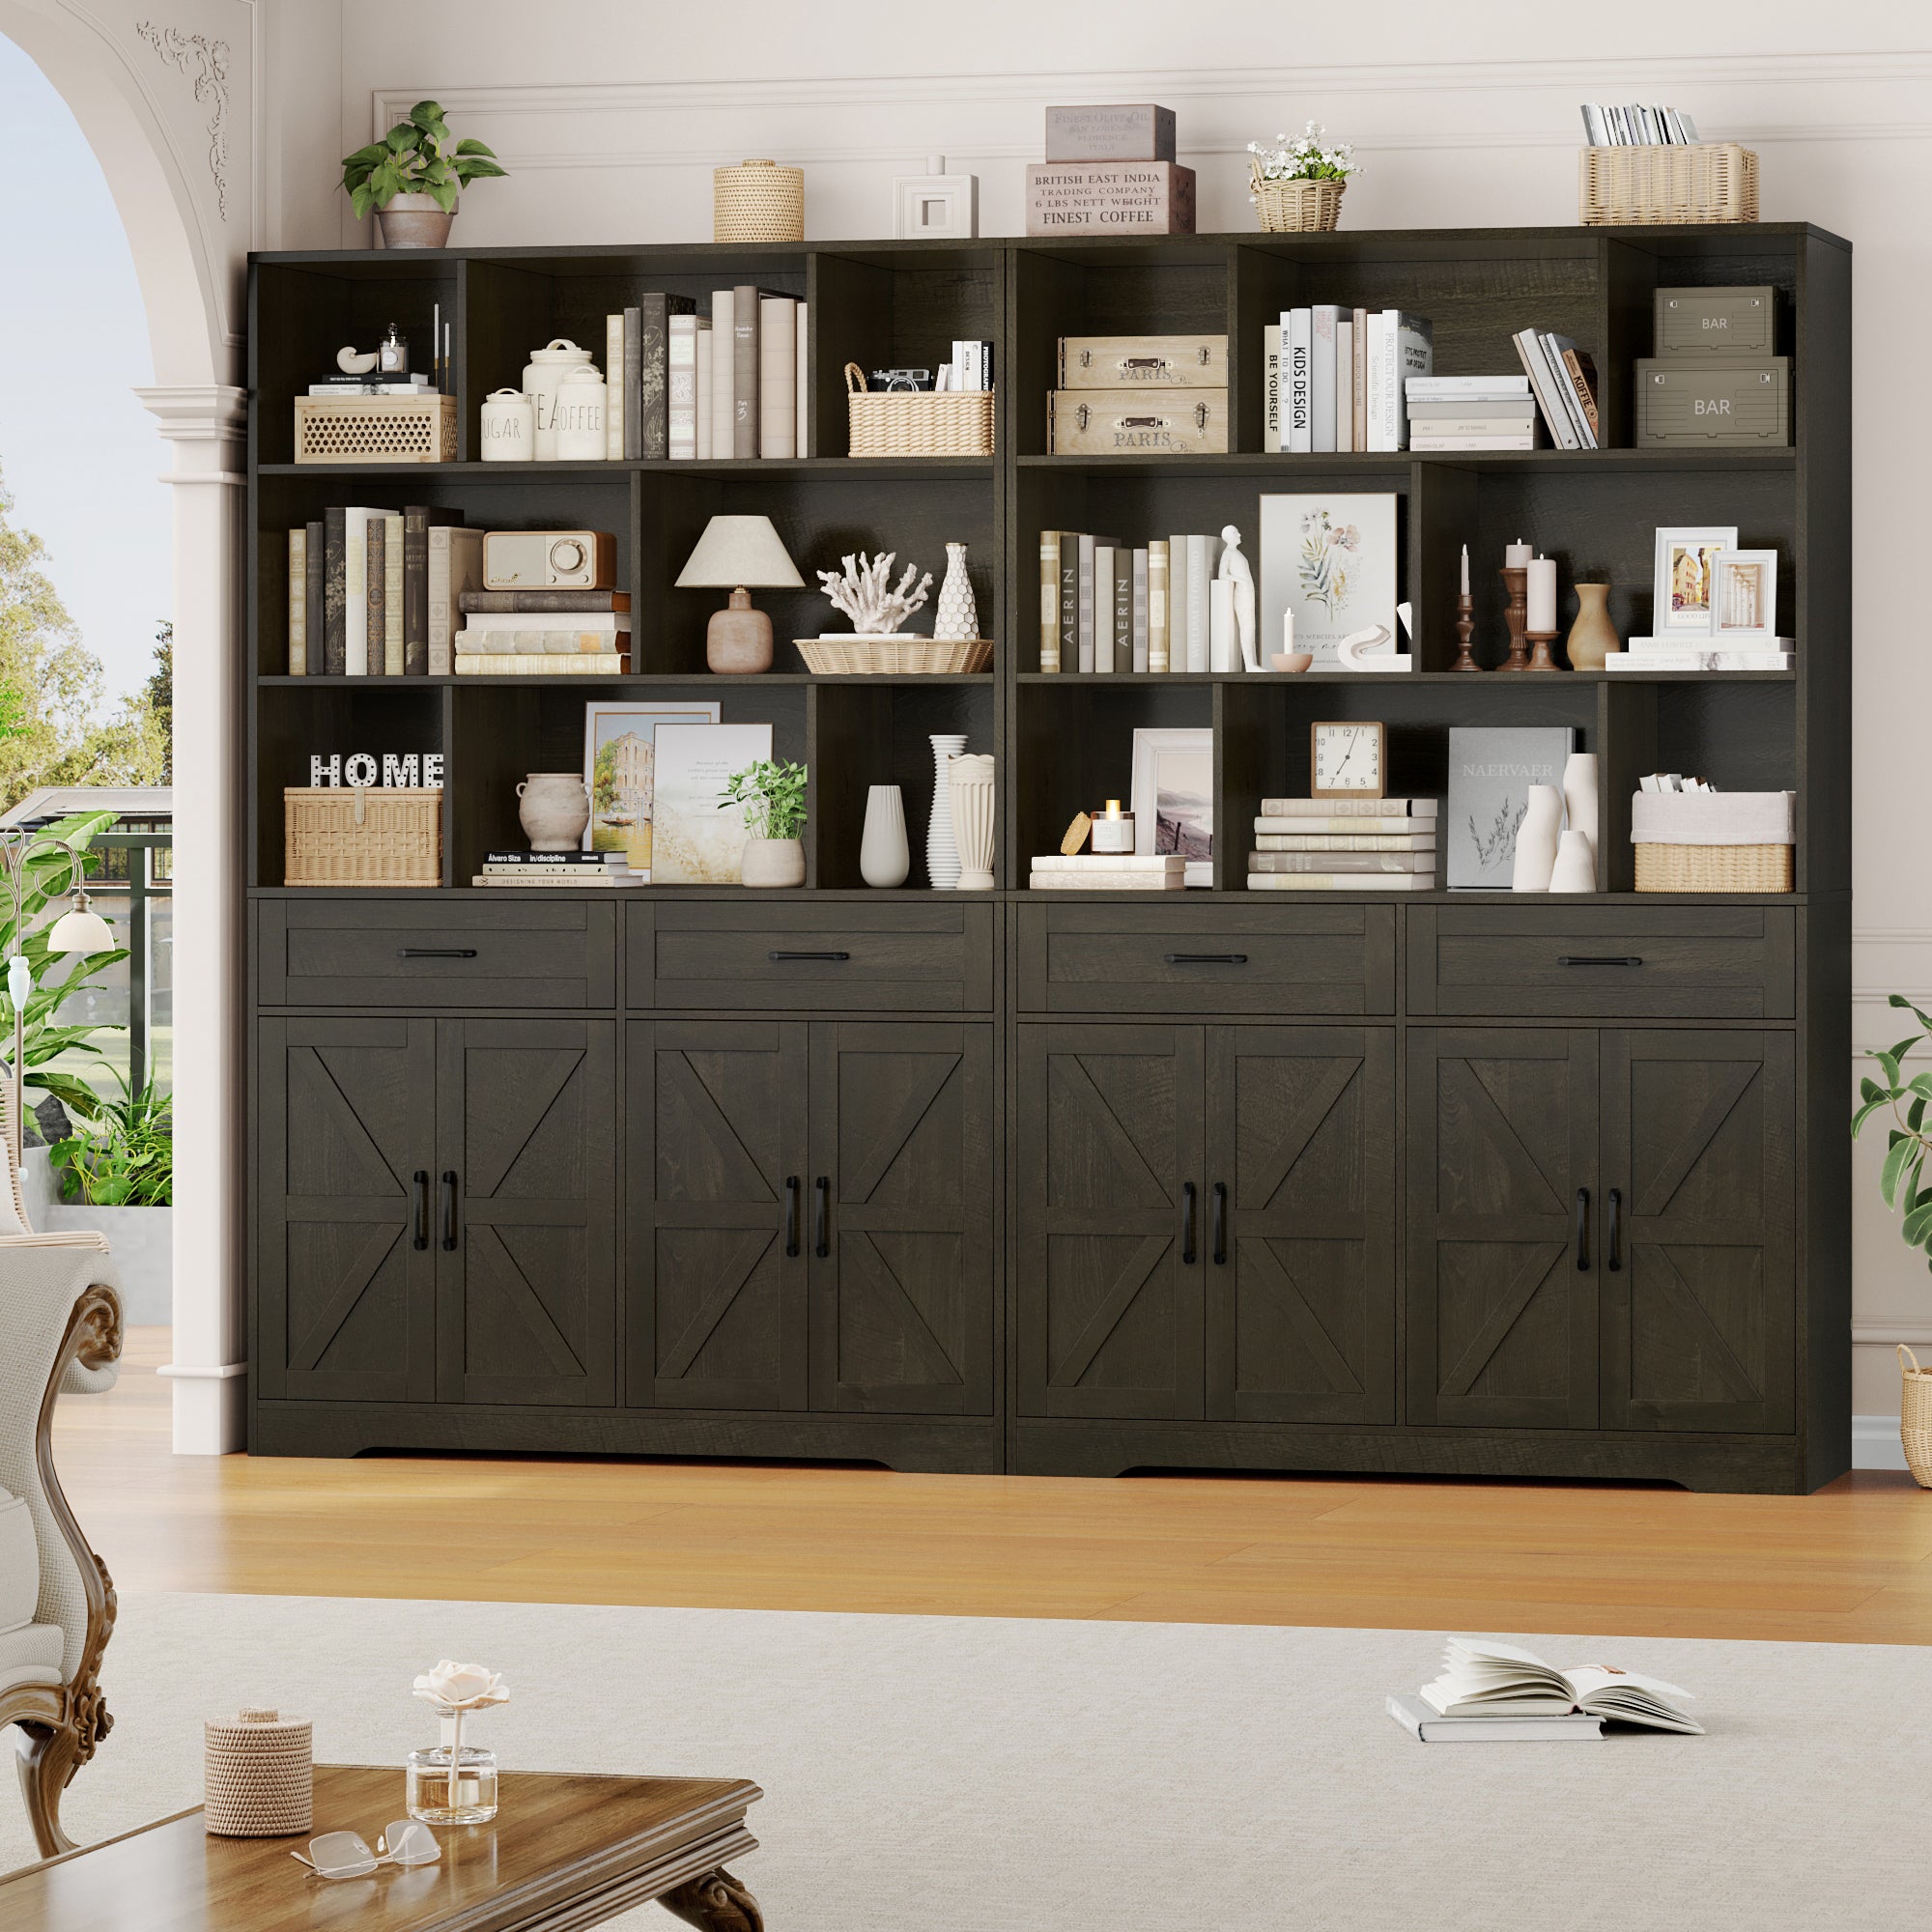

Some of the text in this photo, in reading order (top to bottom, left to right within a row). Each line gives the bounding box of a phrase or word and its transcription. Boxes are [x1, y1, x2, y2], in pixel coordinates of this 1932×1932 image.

[1095, 113, 1128, 123] OLIVE
[1130, 112, 1150, 122] OIL
[1035, 173, 1160, 185] BRITISH EAST INDIA
[1111, 198, 1161, 206] WEIGHT
[1043, 211, 1153, 224] FINEST COFFEE
[1702, 318, 1728, 329] BAR
[1282, 357, 1288, 367] TO
[1119, 369, 1171, 380] PARIS
[1294, 347, 1306, 429] KIDS DESIGN
[1385, 333, 1394, 436] PROTECT OUR DESIGN
[1574, 375, 1592, 408] KOFFIE
[1269, 355, 1278, 432] BE YOURSELF
[1694, 399, 1731, 415] BAR
[482, 418, 520, 439] UGAR
[1114, 432, 1172, 447] PARIS
[1063, 569, 1074, 644] AERIN
[1191, 550, 1200, 658] WILLIAM YEOWARD
[1118, 579, 1128, 647] AERIN
[311, 753, 443, 788] HOME
[1462, 764, 1553, 777] NAERVAER
